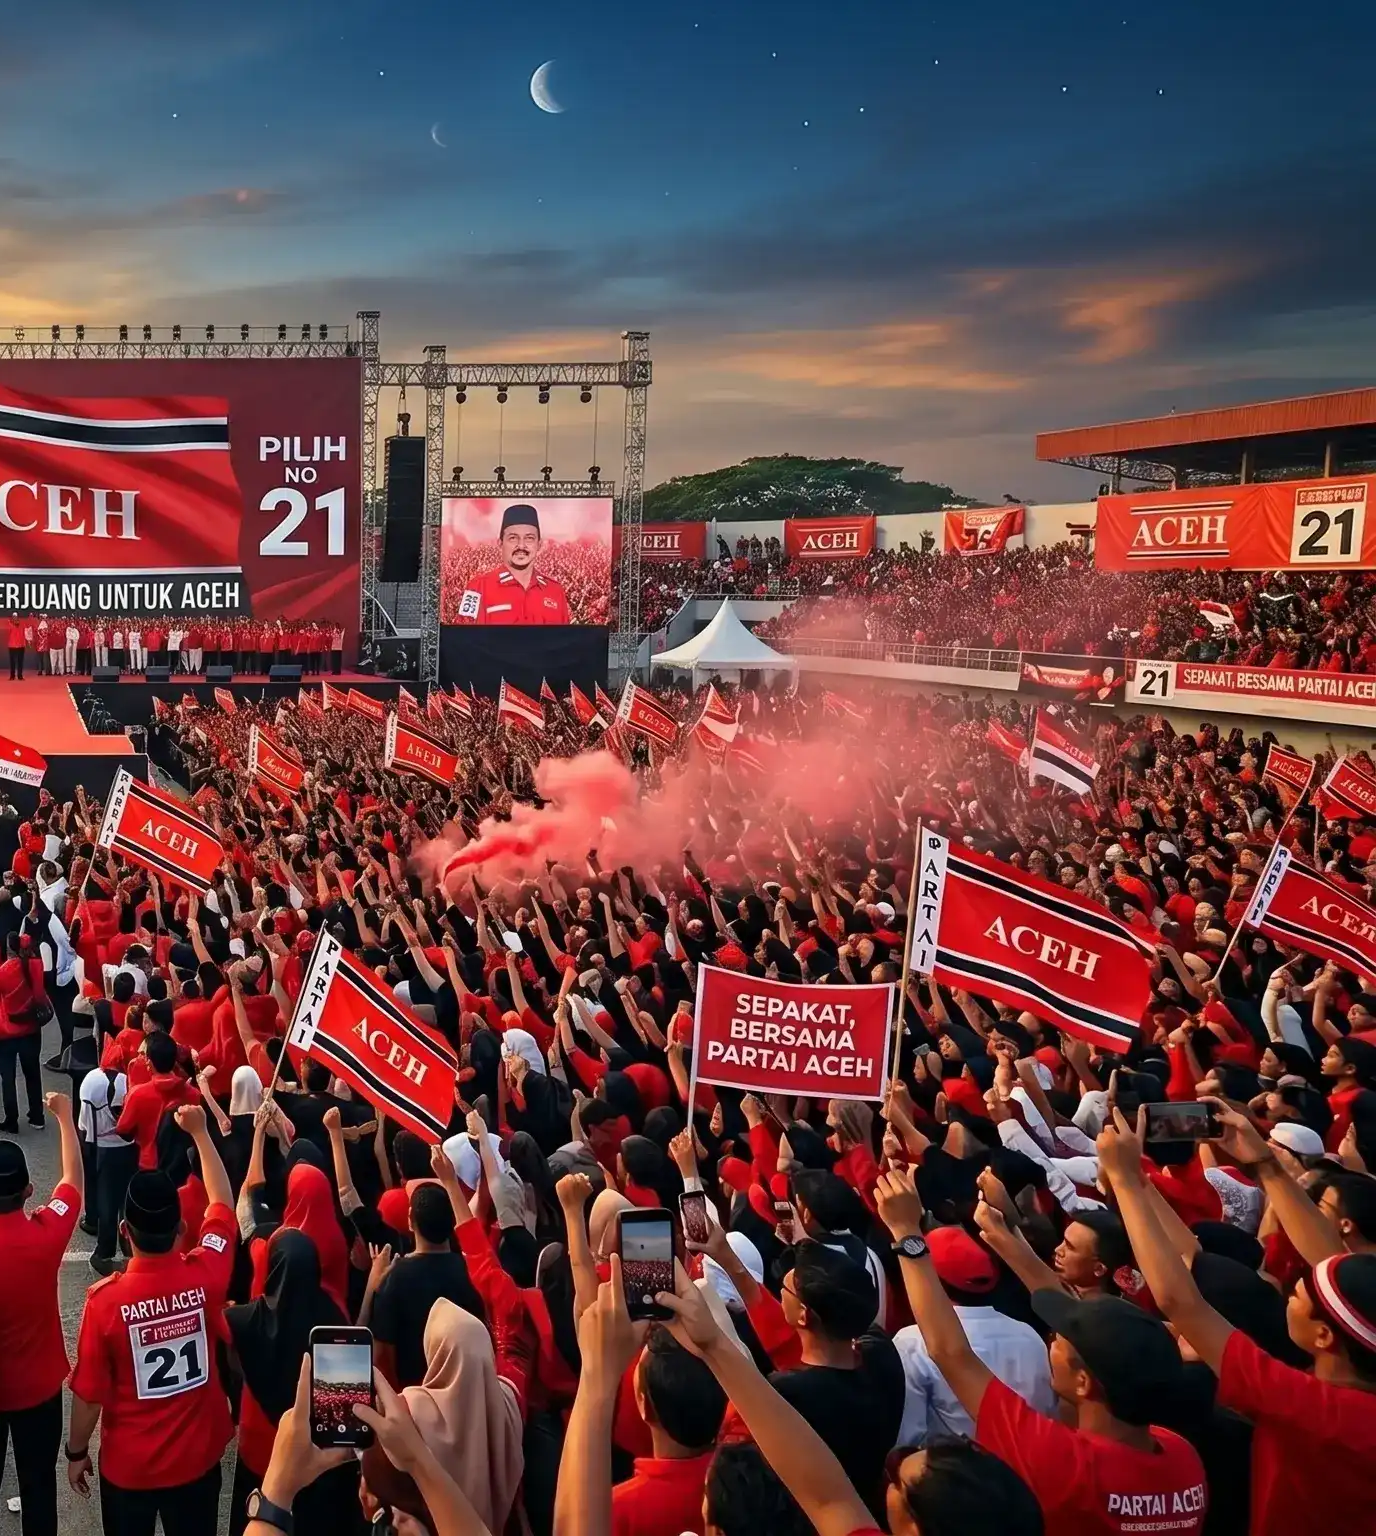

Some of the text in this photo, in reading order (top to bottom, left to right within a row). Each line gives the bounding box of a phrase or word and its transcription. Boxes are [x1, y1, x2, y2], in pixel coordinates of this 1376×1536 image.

[285, 466, 318, 484] NO
[259, 487, 345, 556] 21
[1131, 514, 1228, 548] ACEH
[1298, 508, 1355, 556] 21
[801, 532, 859, 550] ACEH
[98, 582, 174, 610] UNTUK
[180, 581, 240, 608] ACEH
[1139, 669, 1168, 697] 21
[1298, 676, 1342, 697] PARTAI
[140, 817, 199, 860] ACEH
[983, 915, 1102, 981] ACEH
[297, 939, 339, 1044] PARTAI
[736, 993, 856, 1030] SEPAKAT,
[351, 1016, 429, 1087] ACEH
[730, 1018, 856, 1051] BERSAMA
[707, 1040, 873, 1078] PARTAI ACEH
[120, 1286, 207, 1322] PARTAI ACEH
[144, 1339, 202, 1390] 21
[1108, 1483, 1205, 1517] PARTAI ACEH
